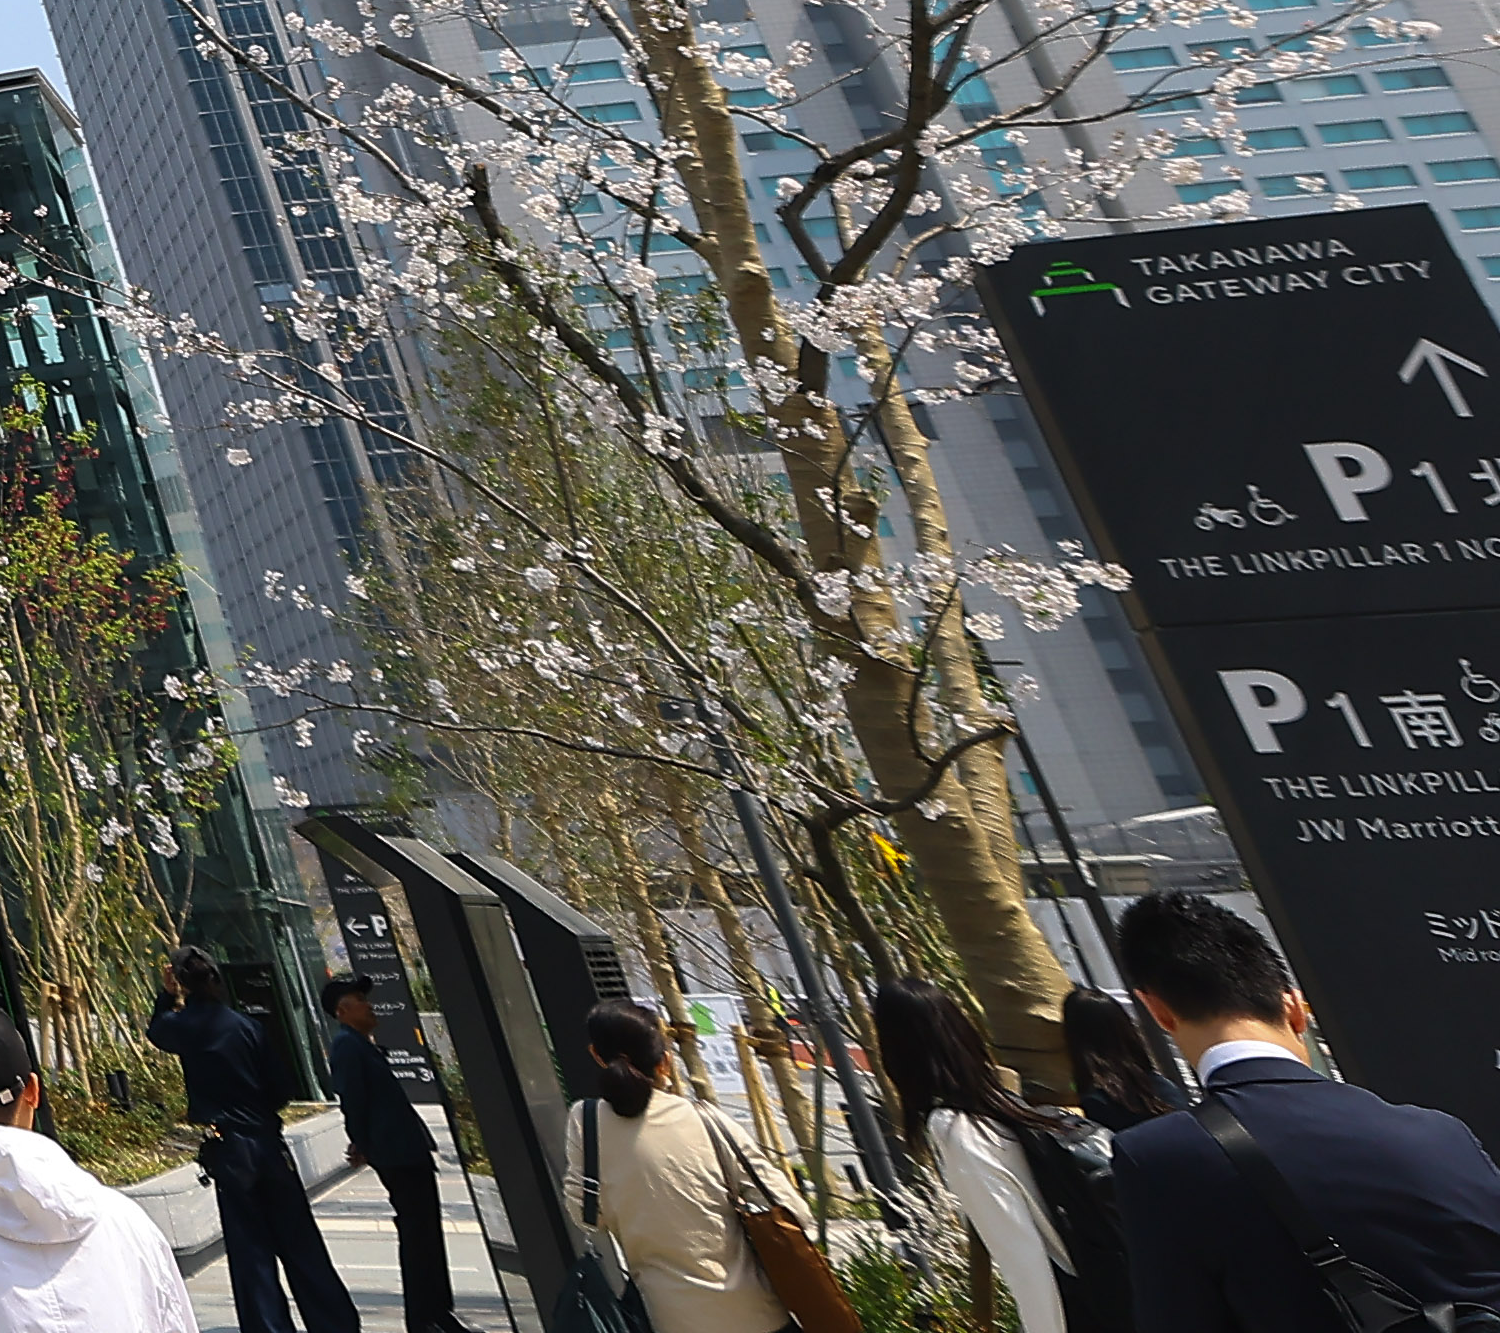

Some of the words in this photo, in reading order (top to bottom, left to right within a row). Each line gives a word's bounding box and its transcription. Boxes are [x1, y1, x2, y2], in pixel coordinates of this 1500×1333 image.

[1130, 239, 1355, 276] TAKANAWA
[1146, 270, 1329, 305] GATEWAY
[1342, 260, 1431, 285] CITY
[1158, 554, 1229, 579] THE
[1231, 543, 1430, 574] LINKPILLAR
[1431, 541, 1452, 562] 1
[1261, 776, 1337, 800] THE
[1339, 769, 1500, 797] LINKPILL
[1297, 818, 1346, 842] JW
[1355, 814, 1500, 840] Marriott
[369, 914, 388, 938] P
